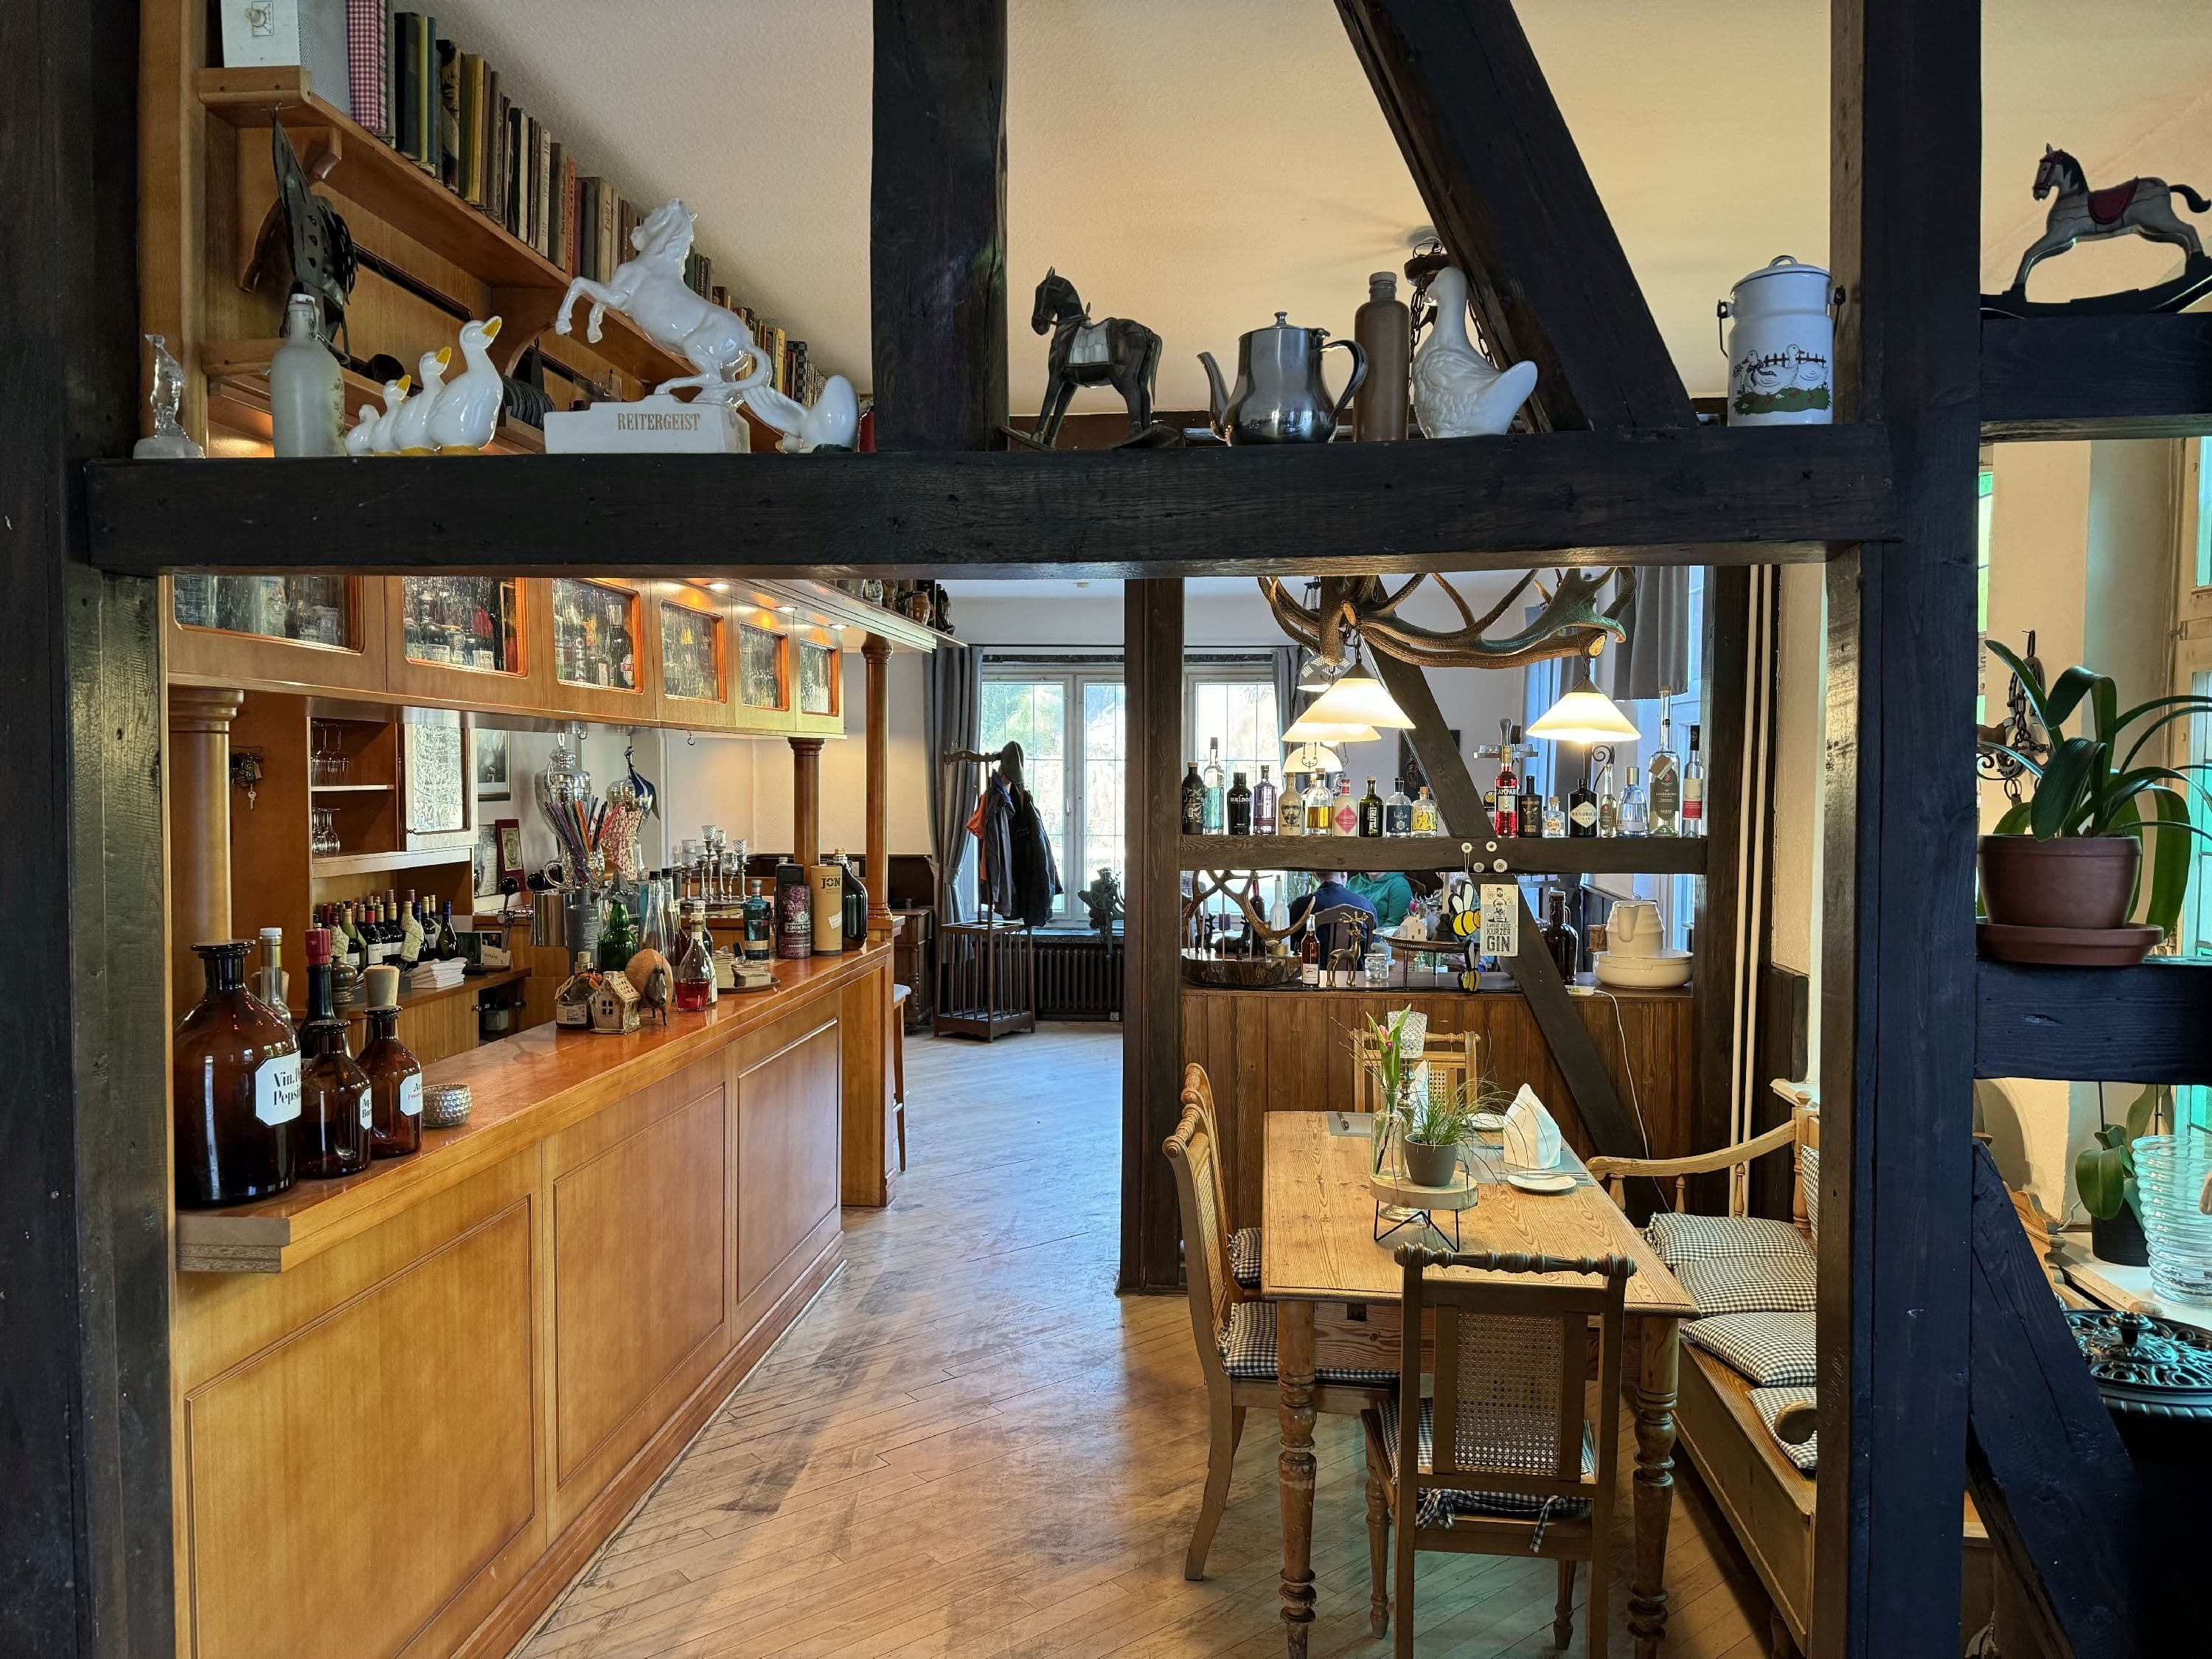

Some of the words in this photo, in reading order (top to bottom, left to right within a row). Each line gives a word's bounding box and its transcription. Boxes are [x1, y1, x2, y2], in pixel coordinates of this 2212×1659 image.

[617, 413, 700, 431] REITERGEIST
[821, 877, 841, 889] JON
[1486, 935, 1510, 952] GIN
